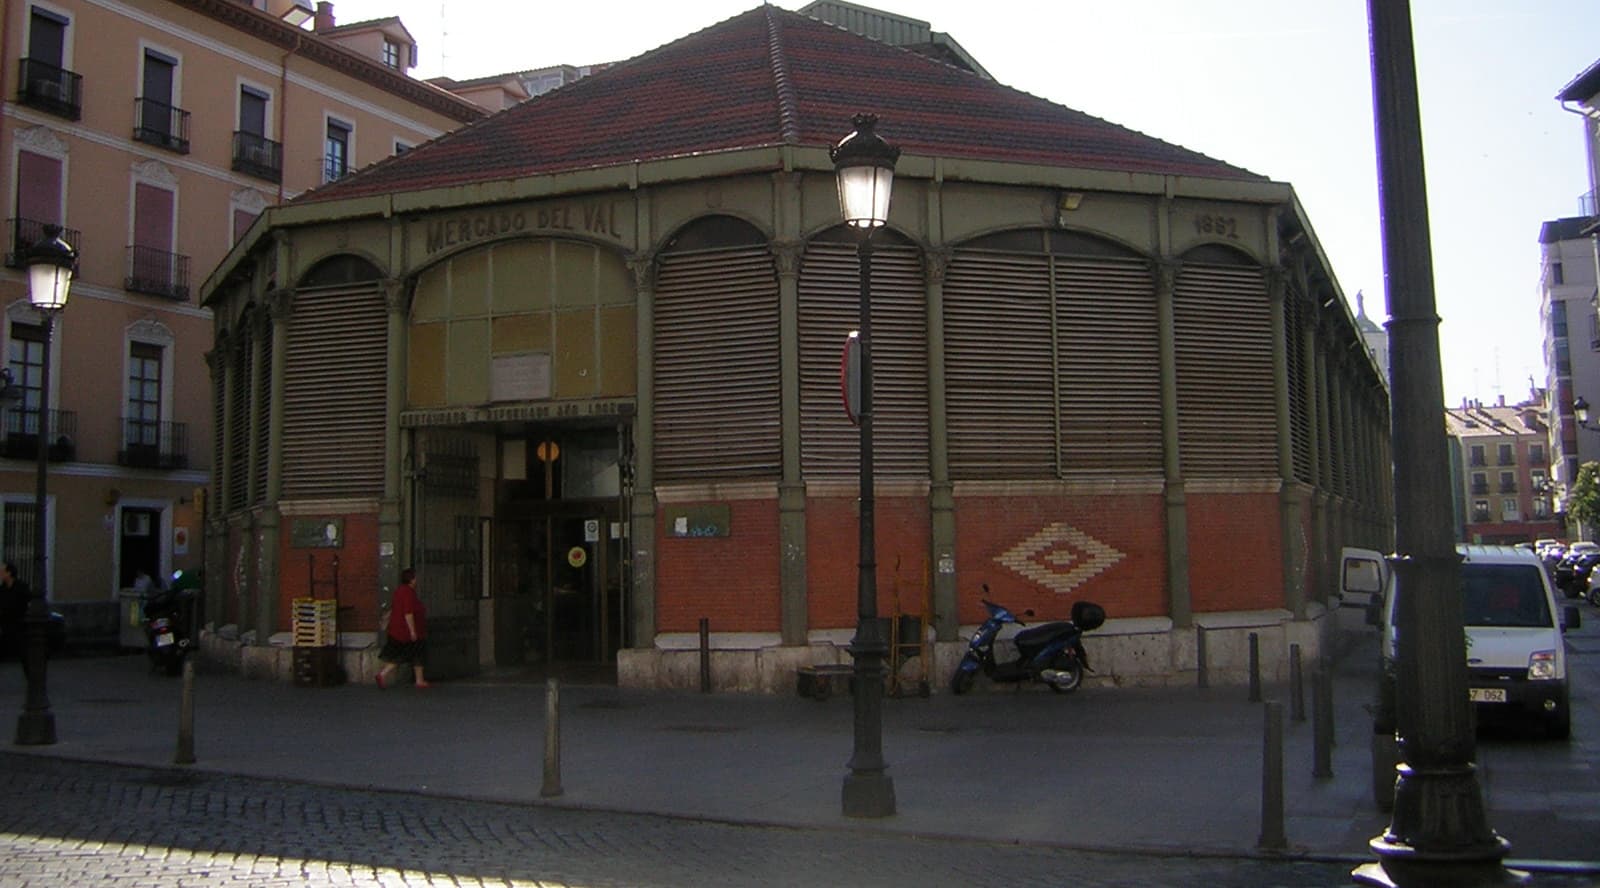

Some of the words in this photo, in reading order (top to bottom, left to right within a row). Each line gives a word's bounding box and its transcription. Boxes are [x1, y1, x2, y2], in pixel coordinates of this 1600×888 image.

[426, 211, 525, 253] MERCADO
[537, 206, 574, 230] DEL
[582, 200, 622, 238] VAL
